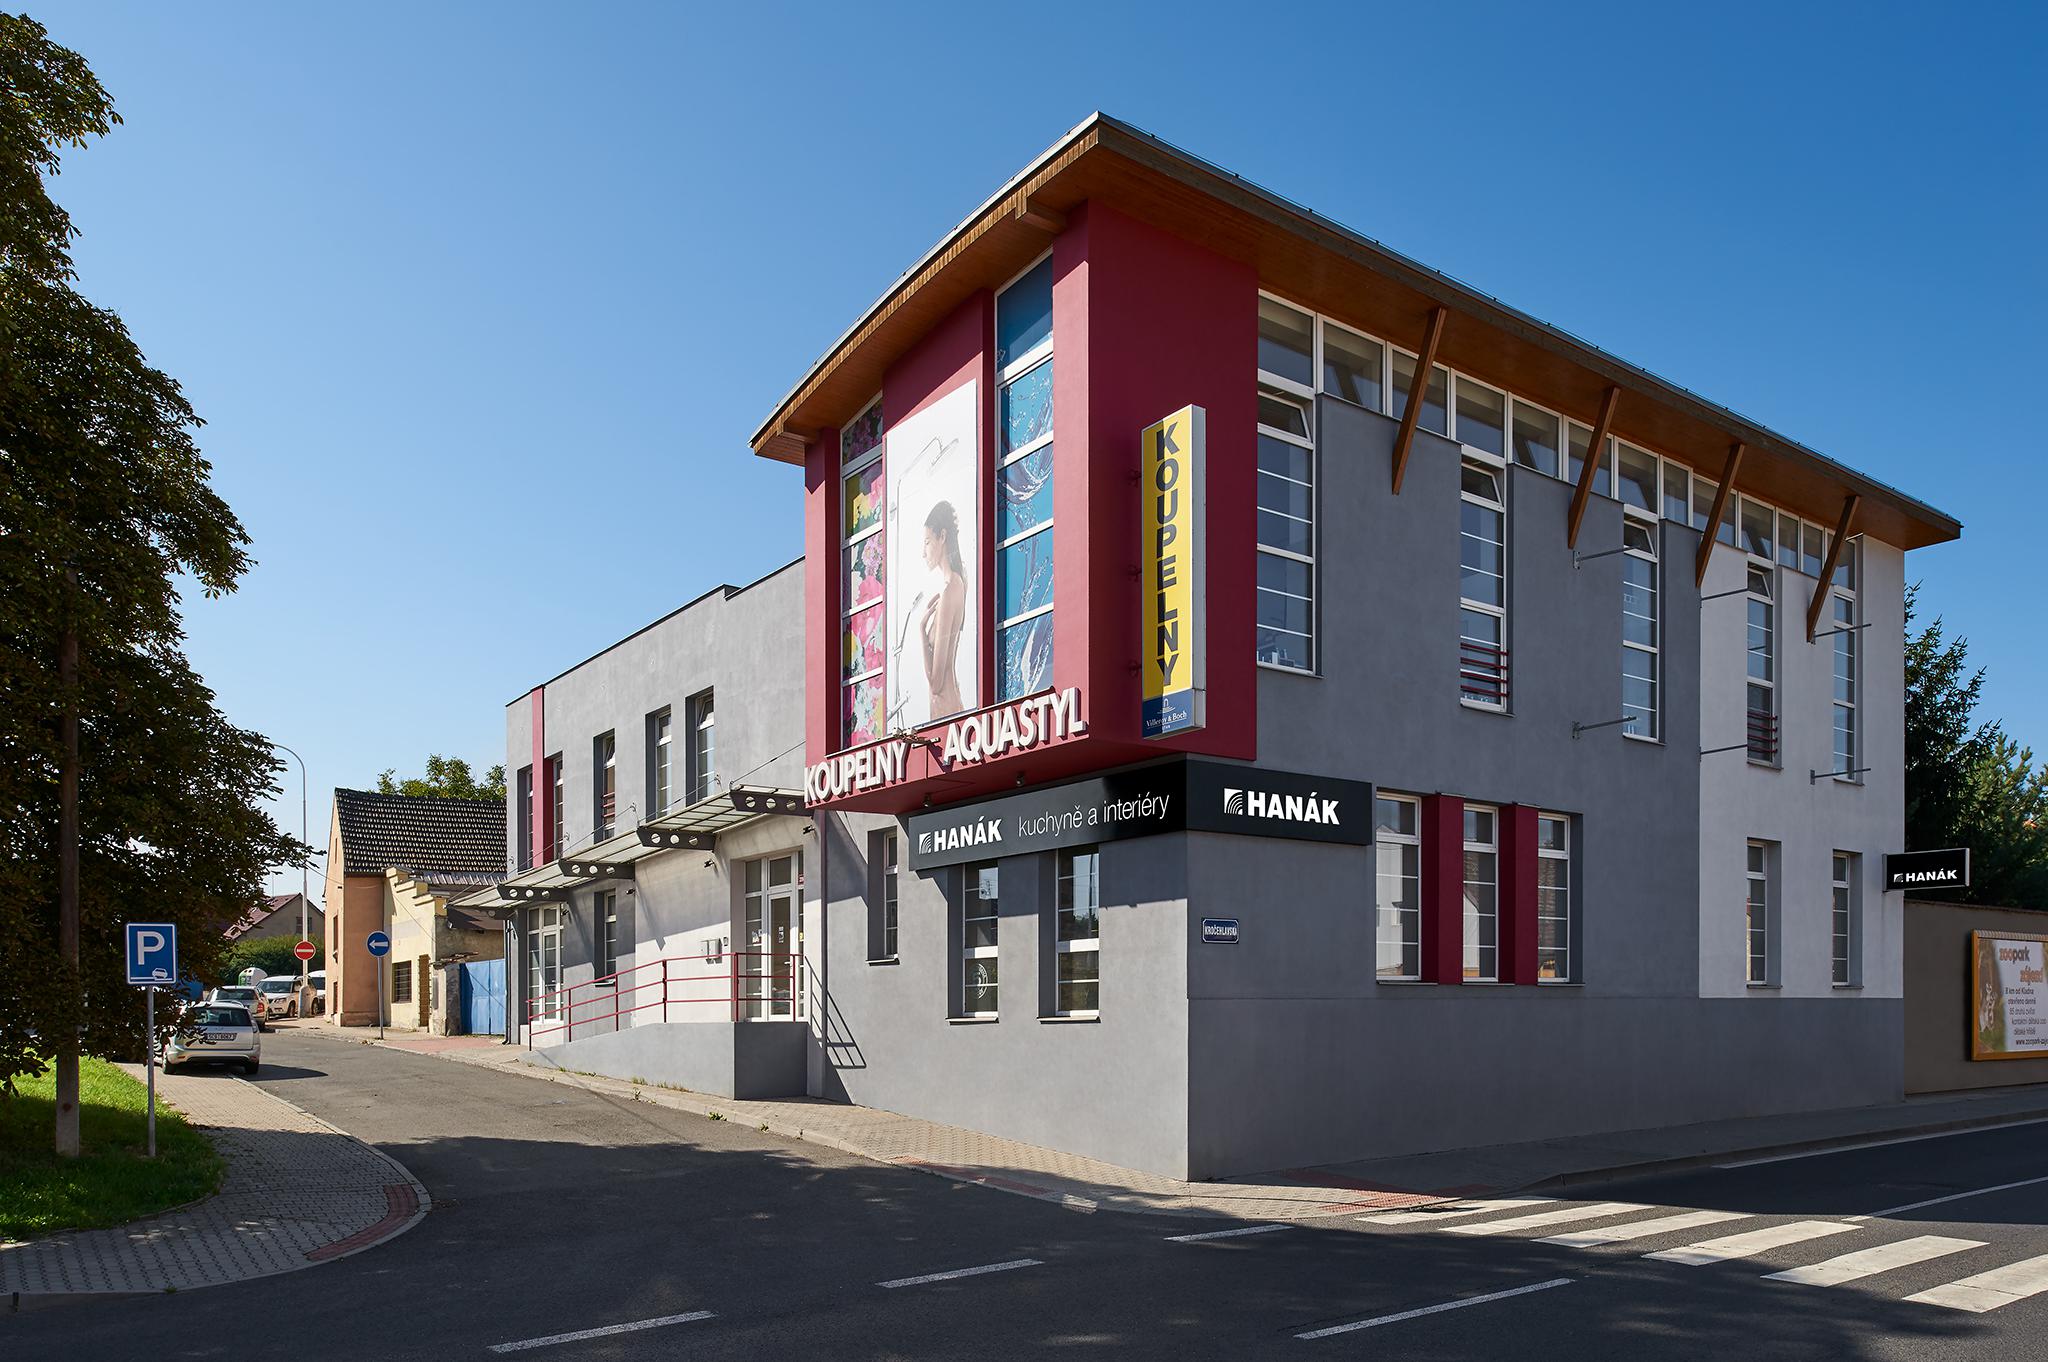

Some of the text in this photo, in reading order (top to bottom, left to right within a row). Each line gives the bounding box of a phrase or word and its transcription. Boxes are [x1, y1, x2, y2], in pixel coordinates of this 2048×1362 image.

[1156, 421, 1180, 687] KOUPELNY
[1172, 710, 1187, 721] Boch
[804, 687, 1087, 803] KOUPELNY AQUASTYL
[934, 792, 1170, 852] HANÁK kuchyně a interiéry
[1246, 790, 1340, 826] HANÁK
[1905, 868, 1957, 883] HANÁK
[137, 931, 165, 965] P
[1999, 946, 2030, 964] zoopark
